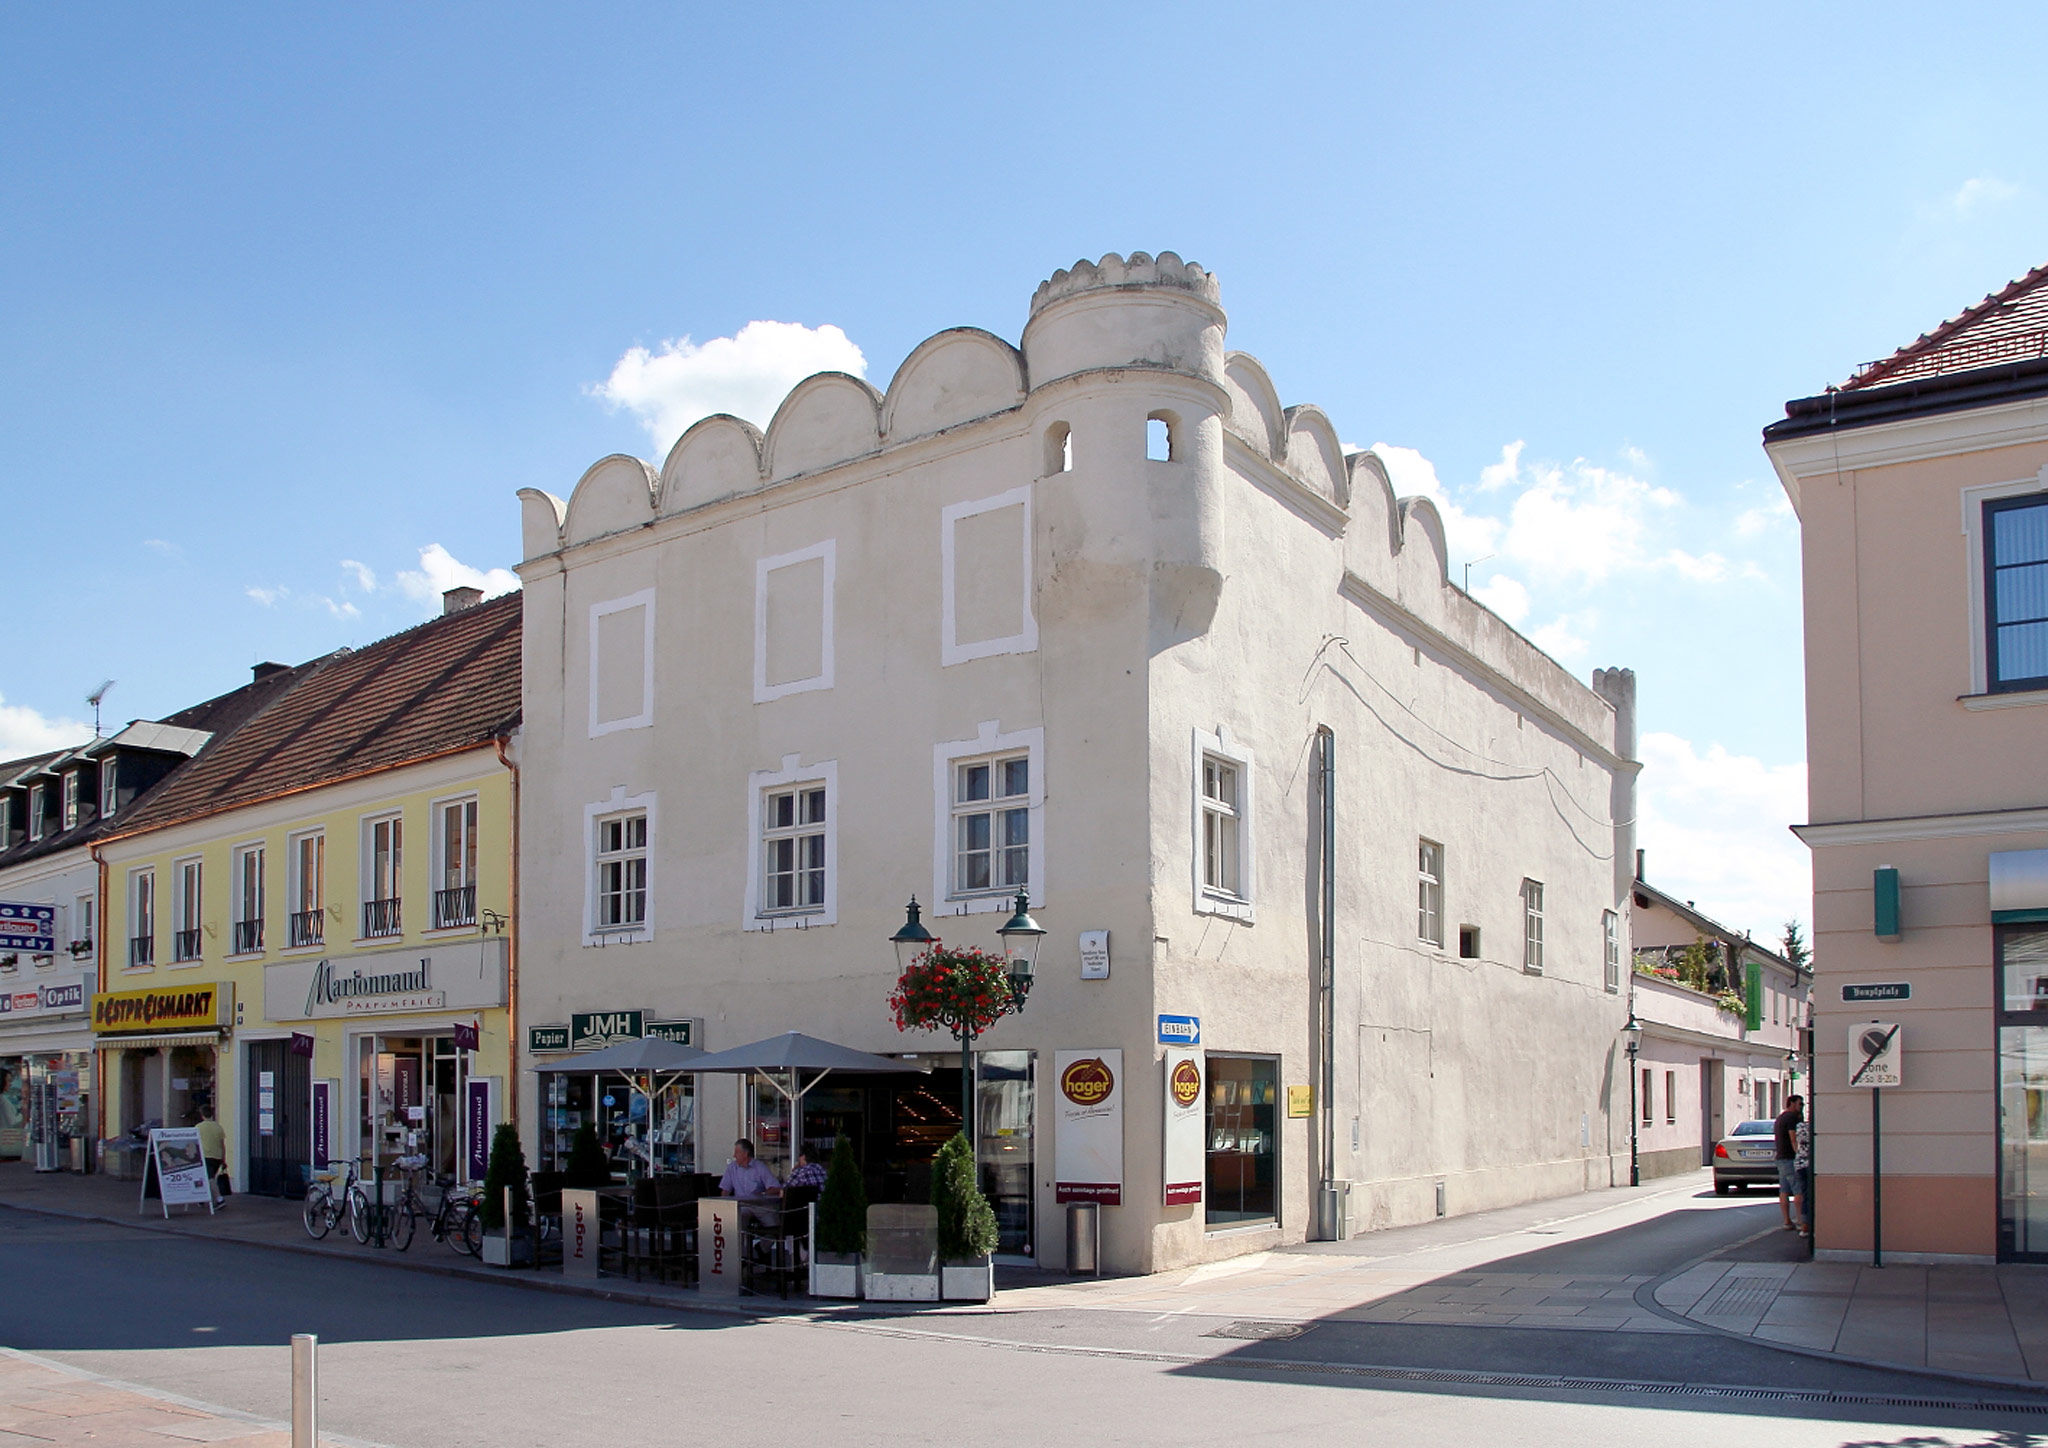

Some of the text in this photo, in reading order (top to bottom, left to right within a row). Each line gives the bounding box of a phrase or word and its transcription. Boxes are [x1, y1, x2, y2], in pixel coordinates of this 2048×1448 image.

[0, 907, 51, 919] oto
[0, 921, 36, 934] rtlauer
[0, 937, 48, 950] andy
[305, 958, 432, 1017] Marionnaud
[47, 988, 80, 1005] Optik
[346, 997, 441, 1011] PARFUMERIES
[584, 1014, 631, 1035] JMH
[1164, 1024, 1192, 1034] EINBAHN
[535, 1031, 564, 1047] Papier
[1066, 1081, 1109, 1096] hager
[1174, 1082, 1198, 1096] hager
[317, 1096, 326, 1158] Marionnaud
[474, 1096, 484, 1166] Marionnaud
[574, 1202, 585, 1258] hager
[711, 1213, 725, 1275] hager
